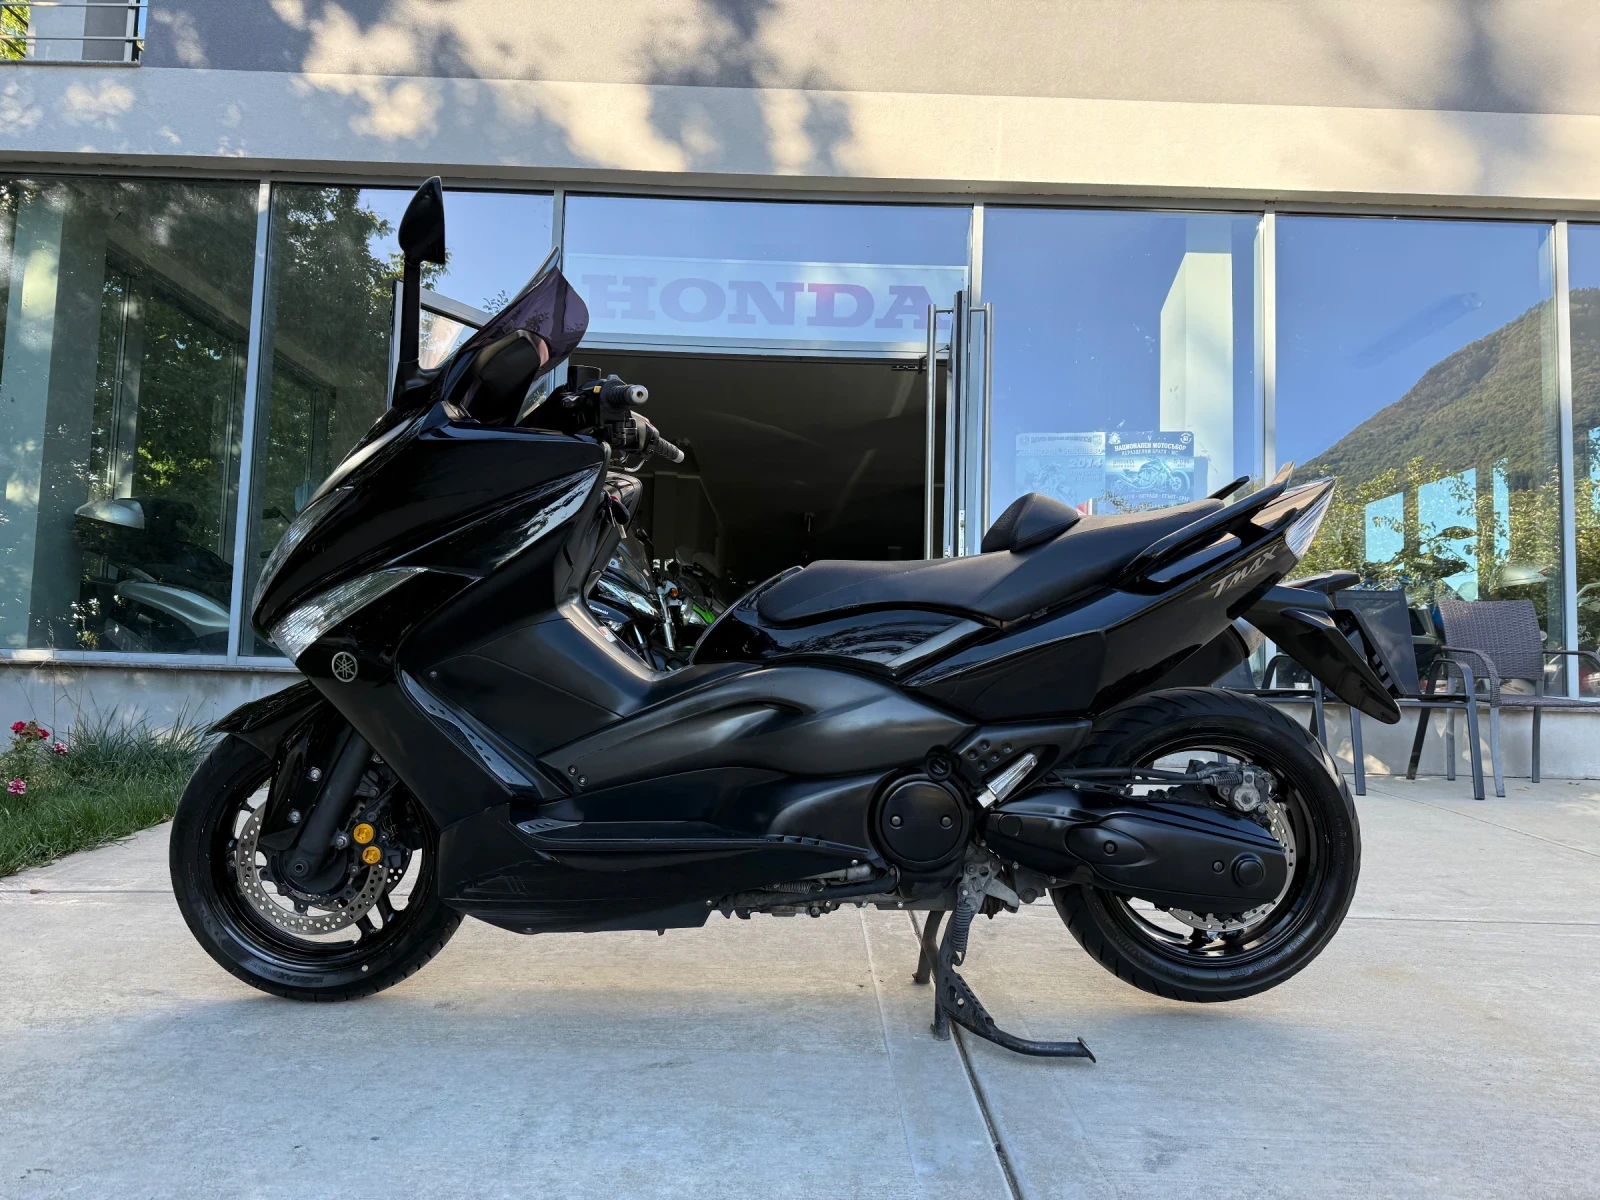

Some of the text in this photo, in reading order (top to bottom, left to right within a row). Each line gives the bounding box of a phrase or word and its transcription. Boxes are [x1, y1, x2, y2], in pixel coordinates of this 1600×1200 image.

[581, 274, 950, 330] HONDA
[1114, 442, 1187, 452] НАЦИОНАЛЕН МОТОСЪБОР
